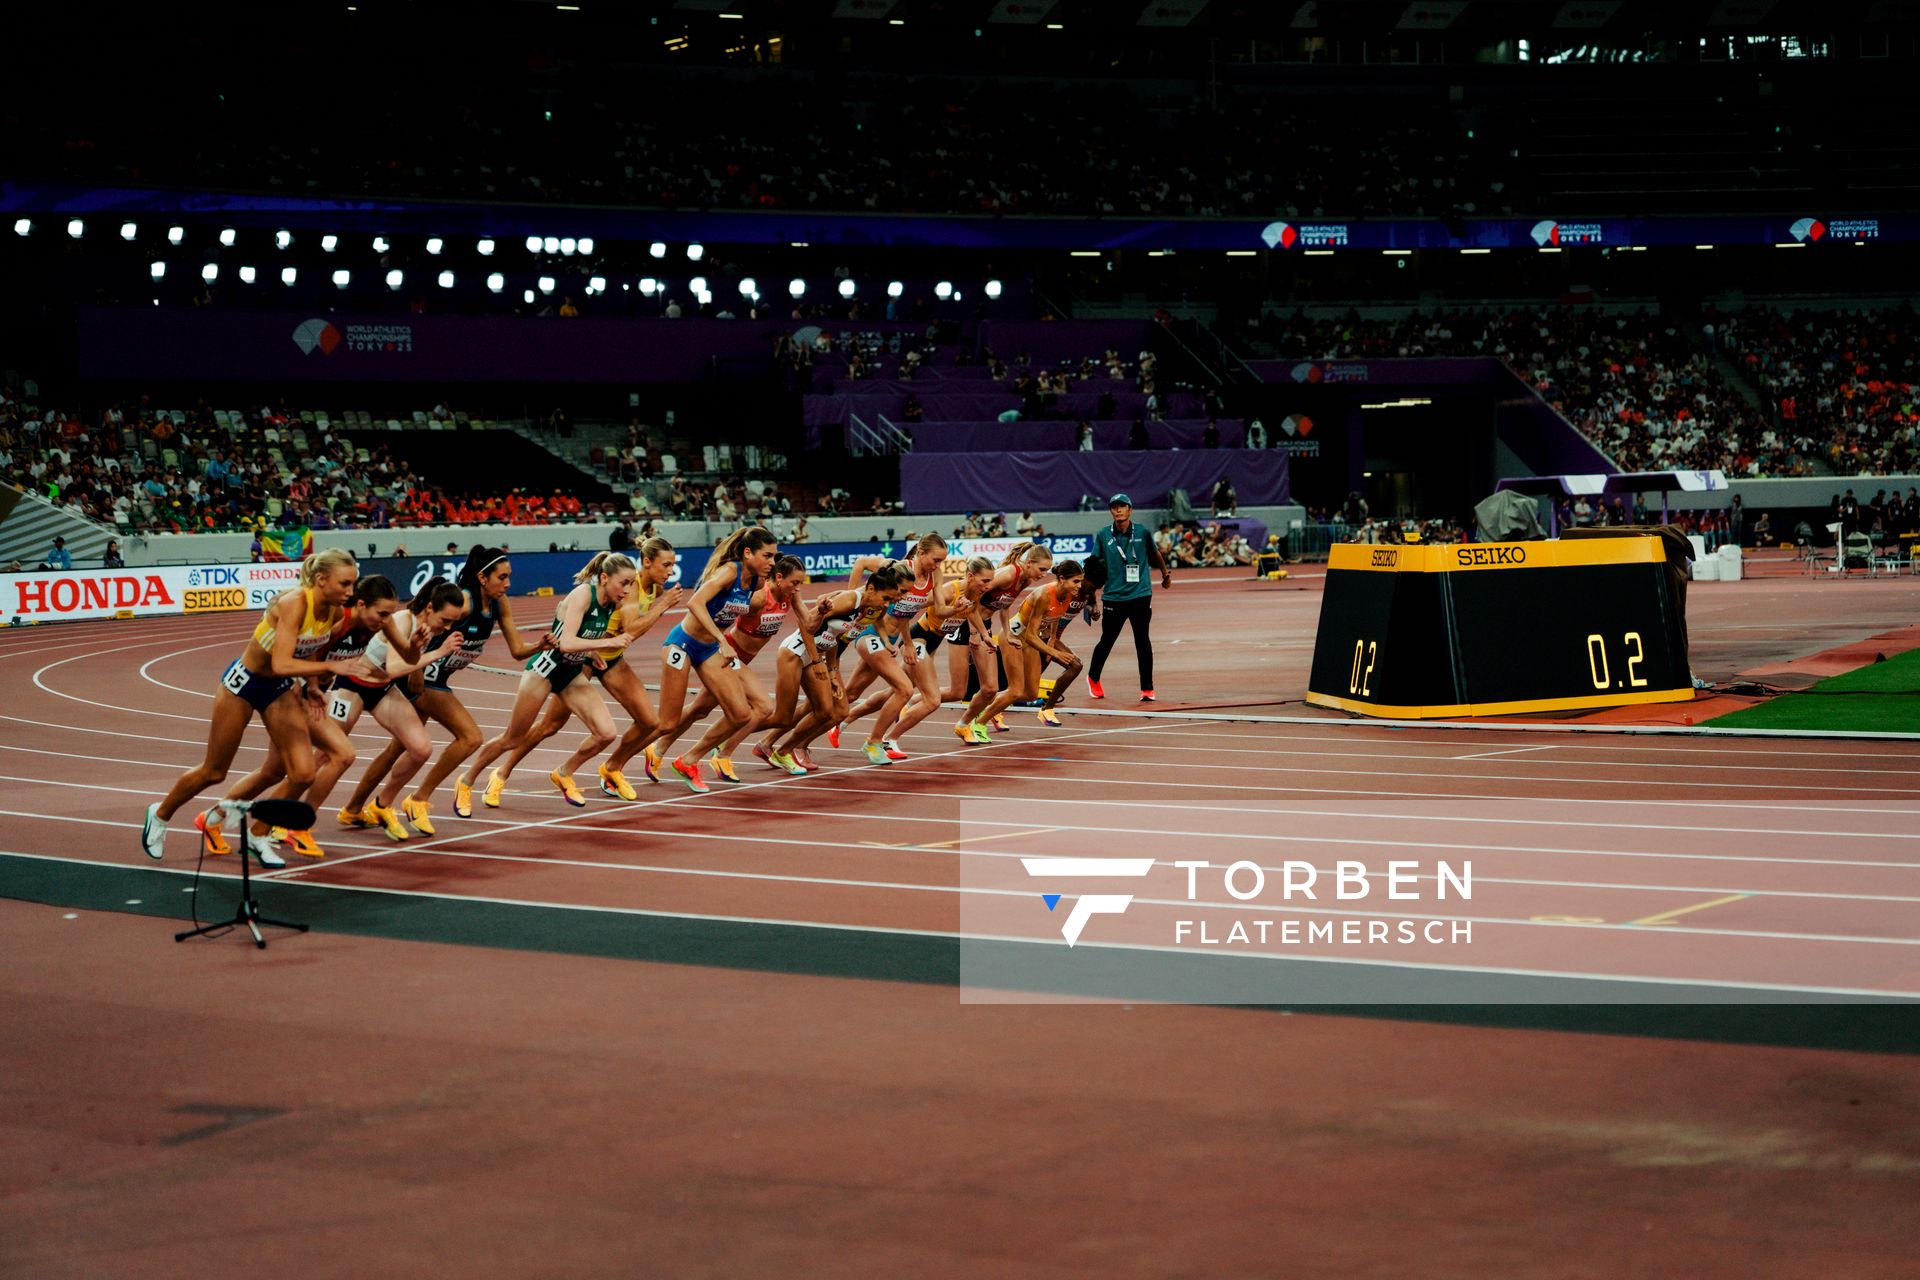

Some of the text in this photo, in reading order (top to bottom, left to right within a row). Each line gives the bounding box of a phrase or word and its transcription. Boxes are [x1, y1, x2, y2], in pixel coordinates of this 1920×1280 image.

[1371, 550, 1397, 567] SEIKO
[1457, 546, 1526, 566] SEIKO
[201, 567, 241, 585] TDK
[15, 575, 174, 614] HONDA
[184, 589, 245, 609] SEIKO
[1011, 622, 1020, 633] 2
[871, 639, 879, 650] 5
[537, 657, 552, 674] 11
[672, 652, 681, 665] 9
[1587, 632, 1648, 689] 0.2
[1349, 640, 1377, 697] 0.2
[227, 668, 245, 689] 15
[333, 700, 346, 718] 13
